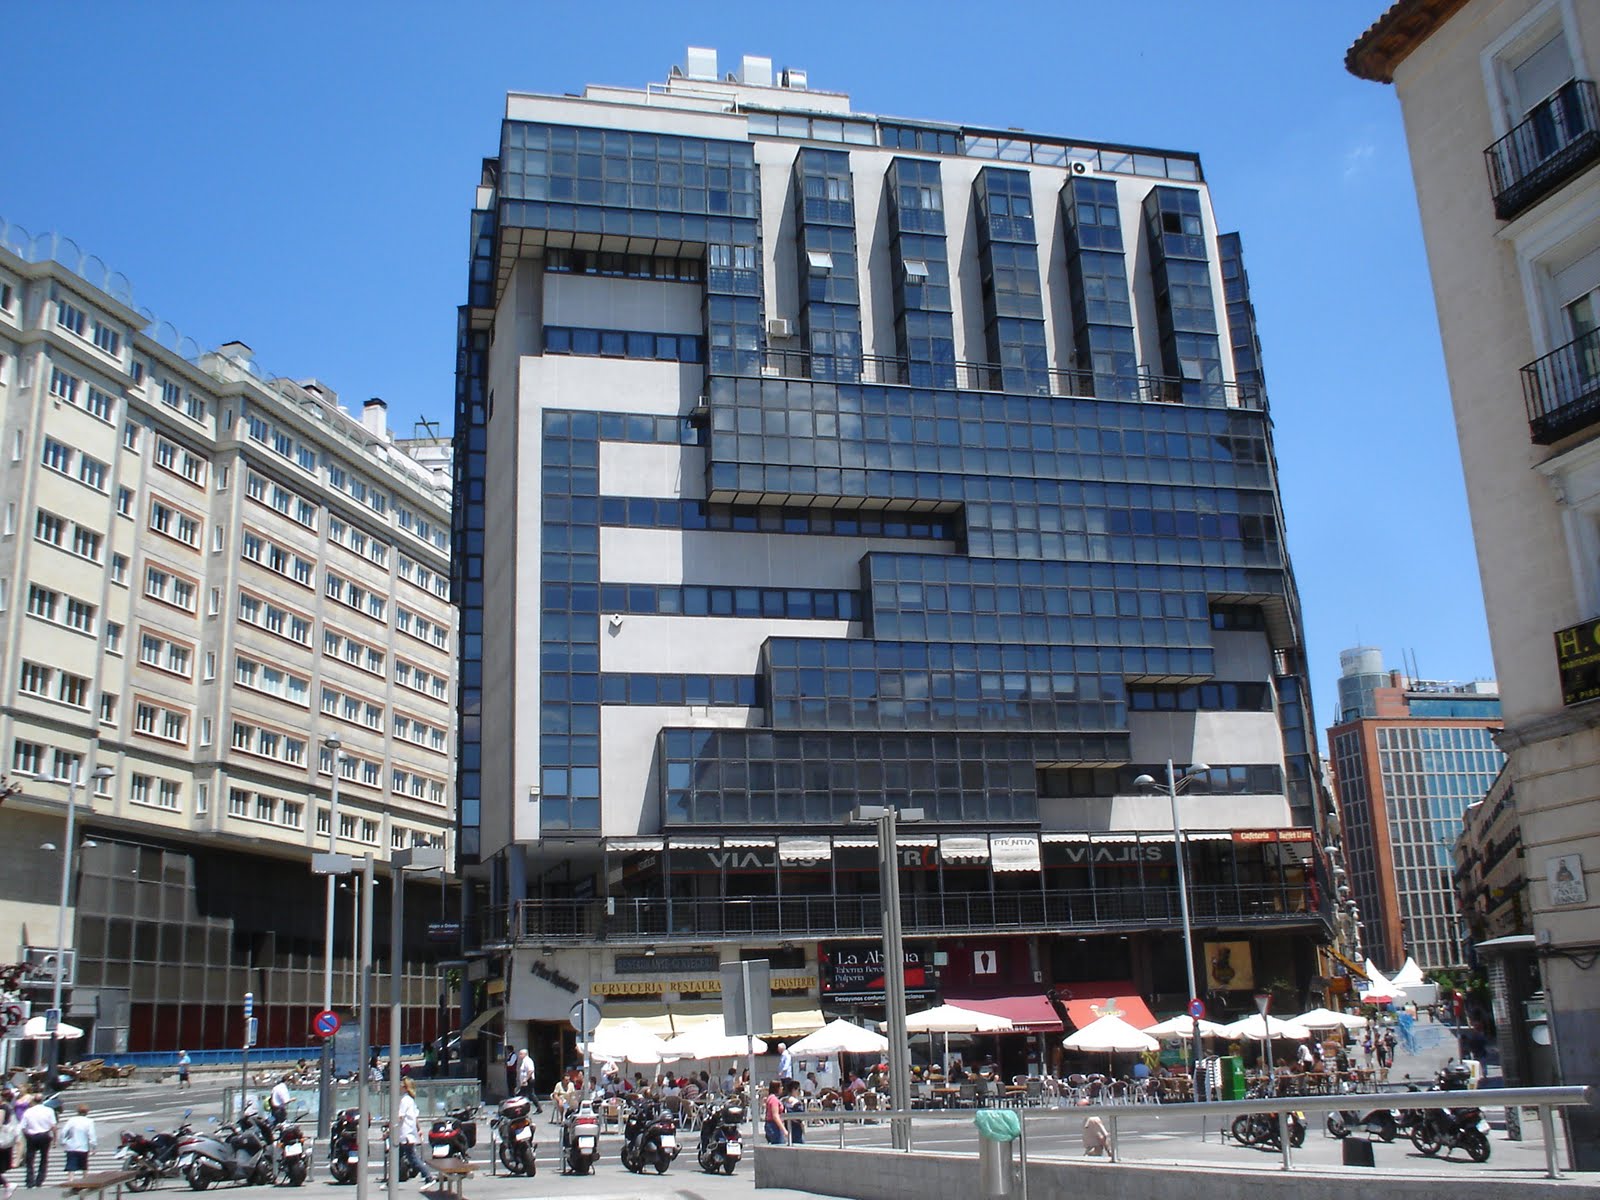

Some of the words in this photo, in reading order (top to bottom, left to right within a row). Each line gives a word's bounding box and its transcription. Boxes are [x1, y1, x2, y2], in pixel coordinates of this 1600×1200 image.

[1065, 846, 1163, 862] VIAJES
[838, 952, 857, 964] La
[593, 982, 663, 993] CERVECERIA
[670, 980, 722, 992] RESTAURA
